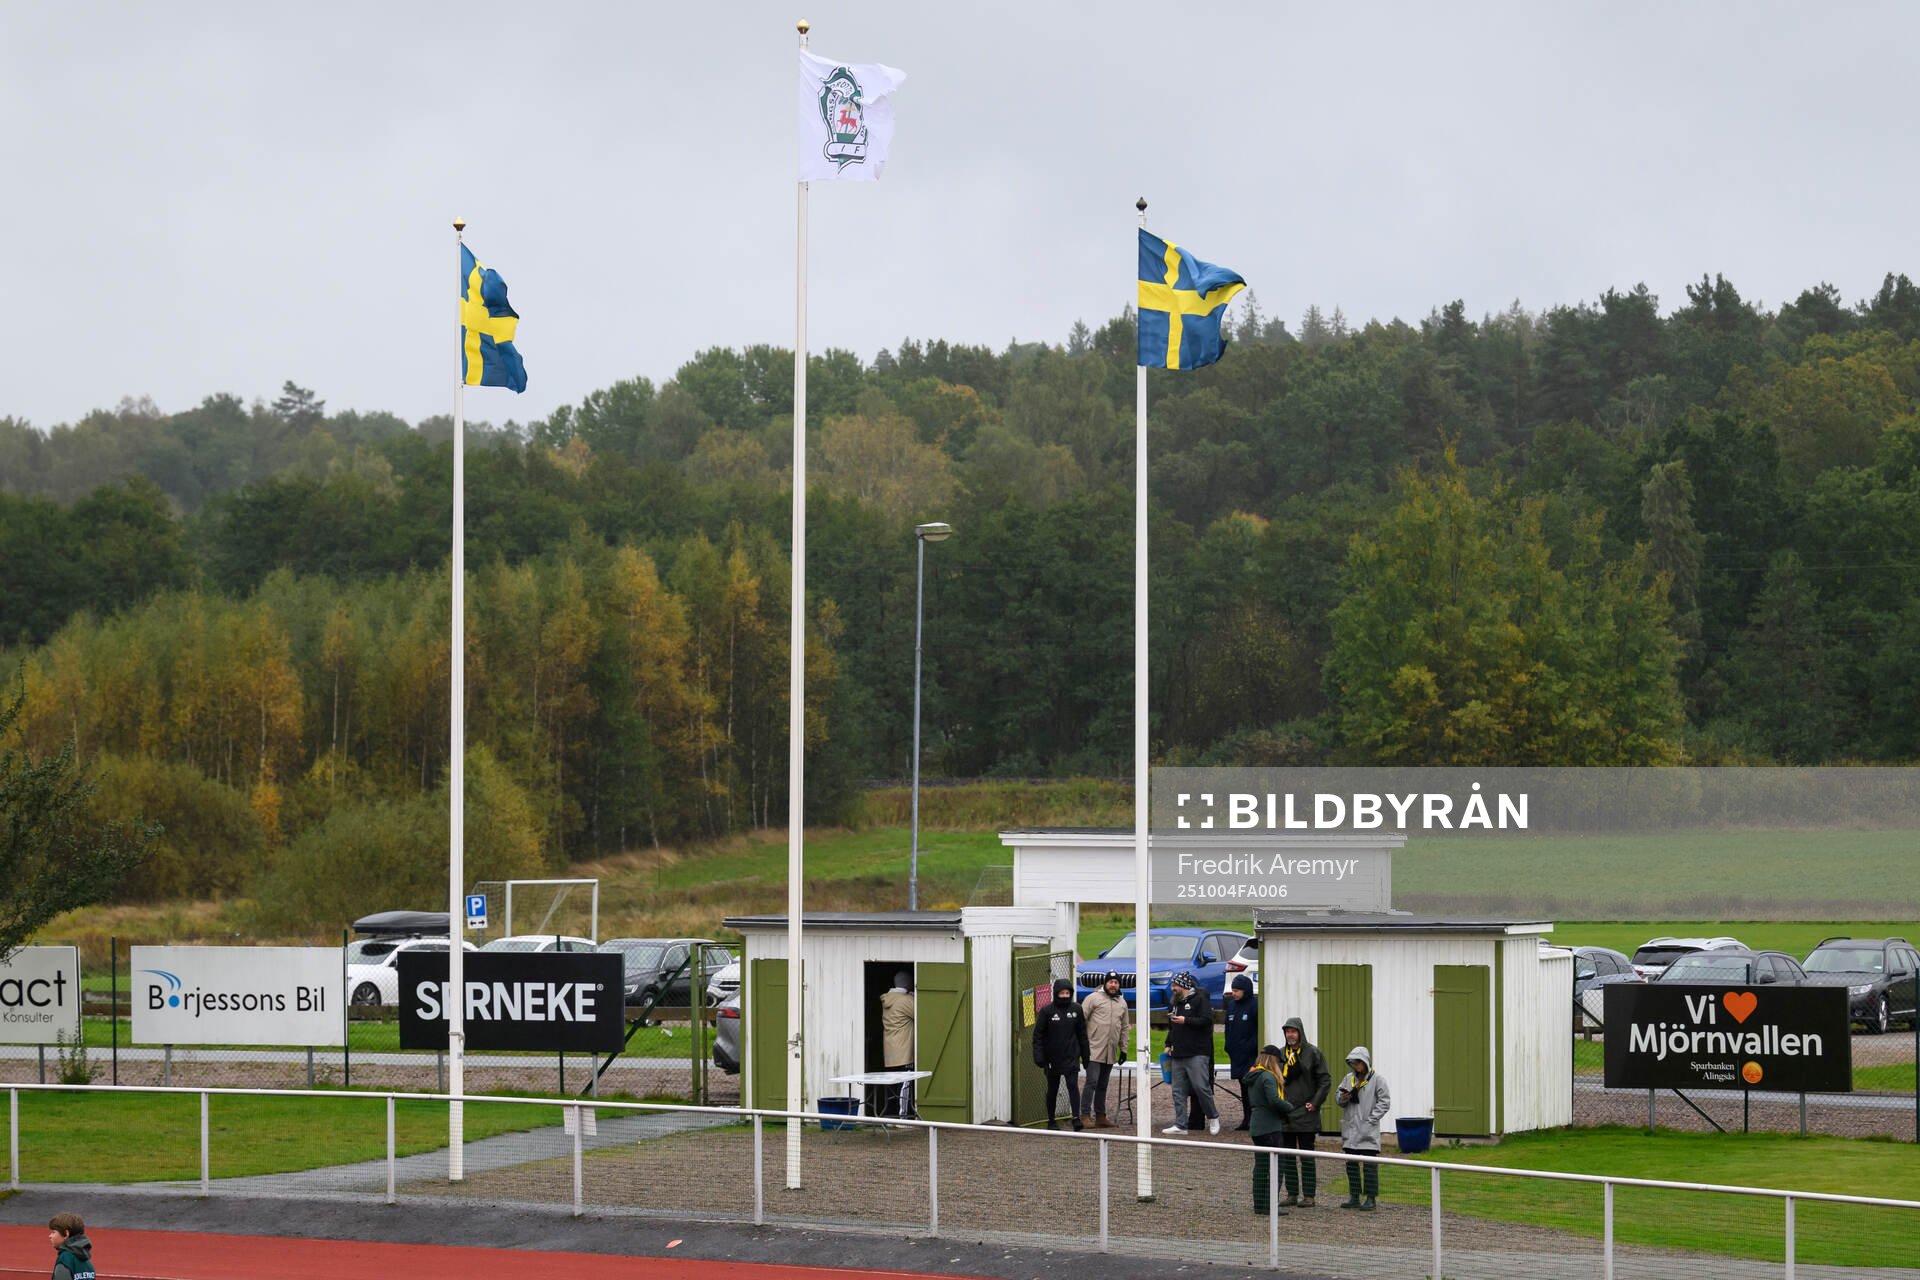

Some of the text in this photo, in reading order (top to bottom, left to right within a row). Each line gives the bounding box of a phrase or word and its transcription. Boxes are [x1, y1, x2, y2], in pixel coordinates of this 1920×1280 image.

[471, 897, 483, 915] P
[0, 970, 67, 1007] act
[296, 986, 325, 1012] Bil
[3, 1012, 54, 1023] Konsulter
[1684, 994, 1716, 1025] Vi
[1628, 1022, 1823, 1061] Mjörnvallen
[1690, 1061, 1735, 1072] Sparbanken
[1702, 1071, 1736, 1082] Alingsås
